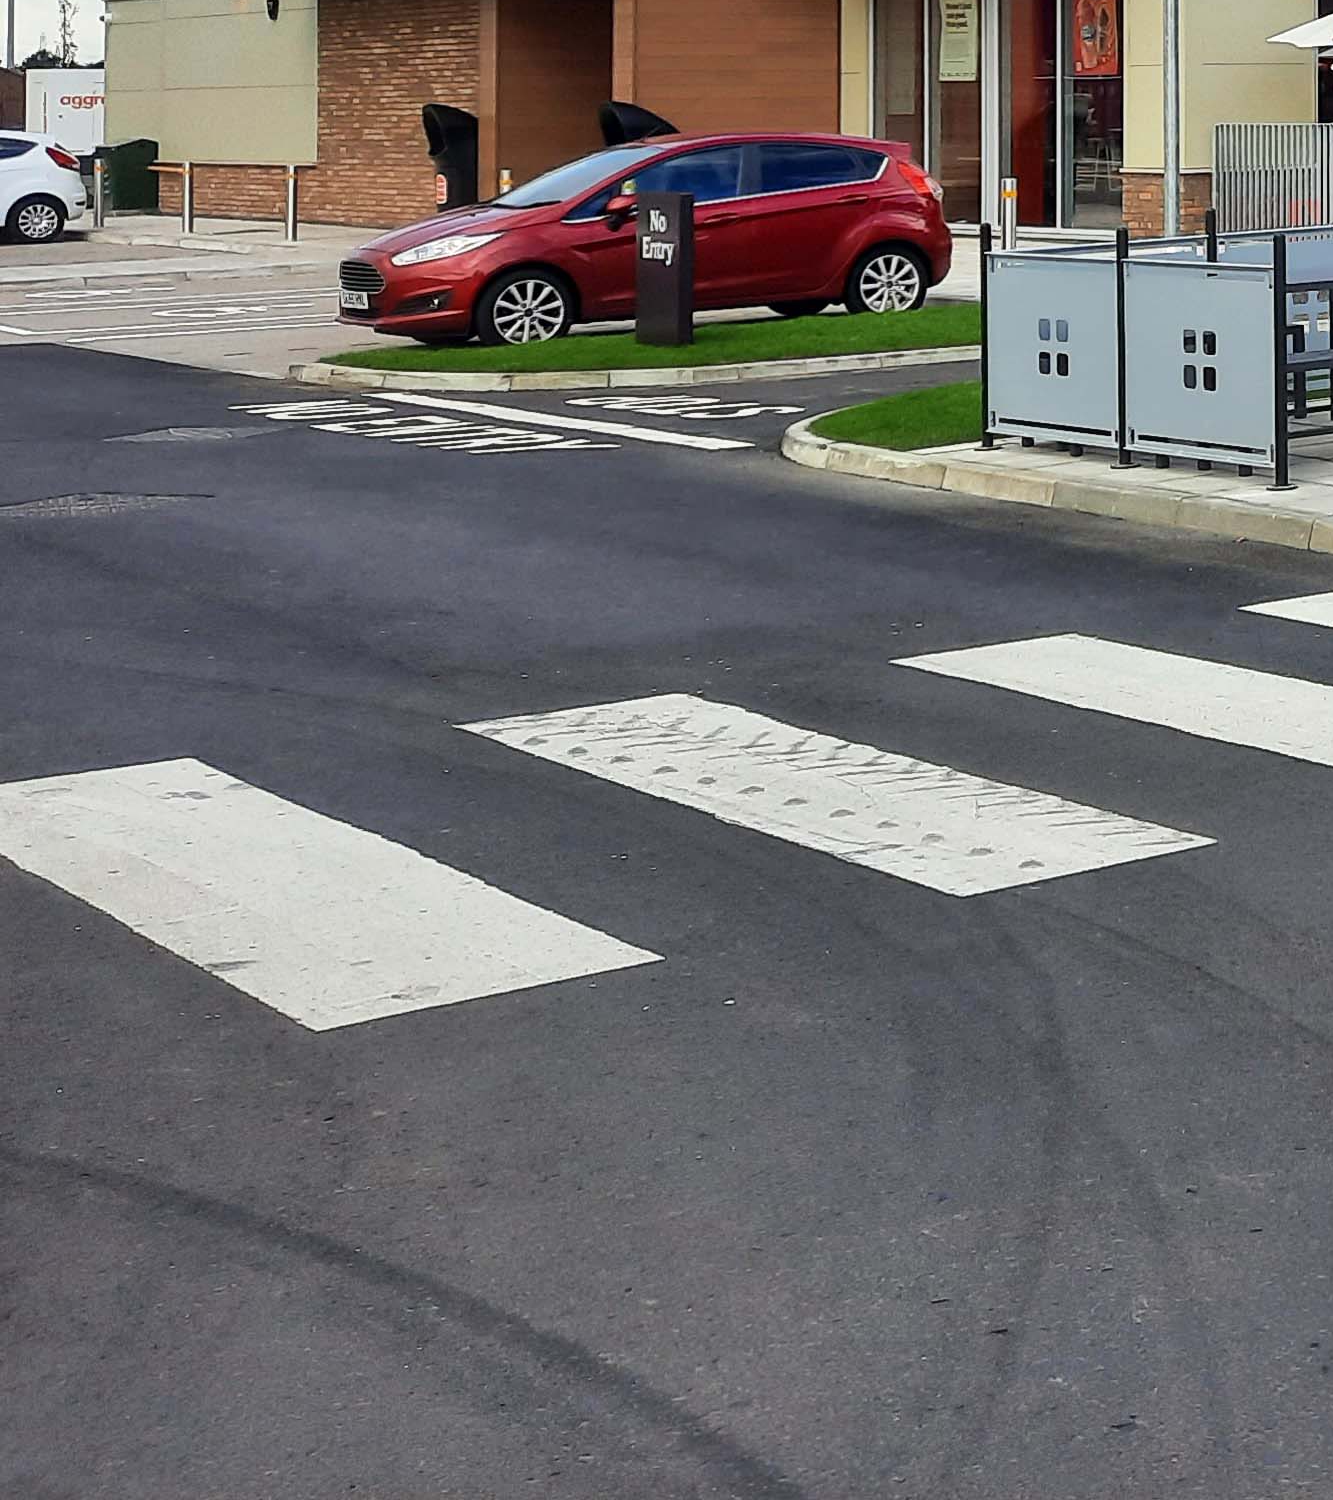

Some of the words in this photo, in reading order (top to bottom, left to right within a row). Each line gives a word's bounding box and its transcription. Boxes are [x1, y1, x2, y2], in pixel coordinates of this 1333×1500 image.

[649, 209, 668, 233] No
[642, 236, 675, 267] Entry
[226, 399, 396, 421] NO
[564, 394, 807, 419] STOP
[308, 414, 623, 455] ENTRY
